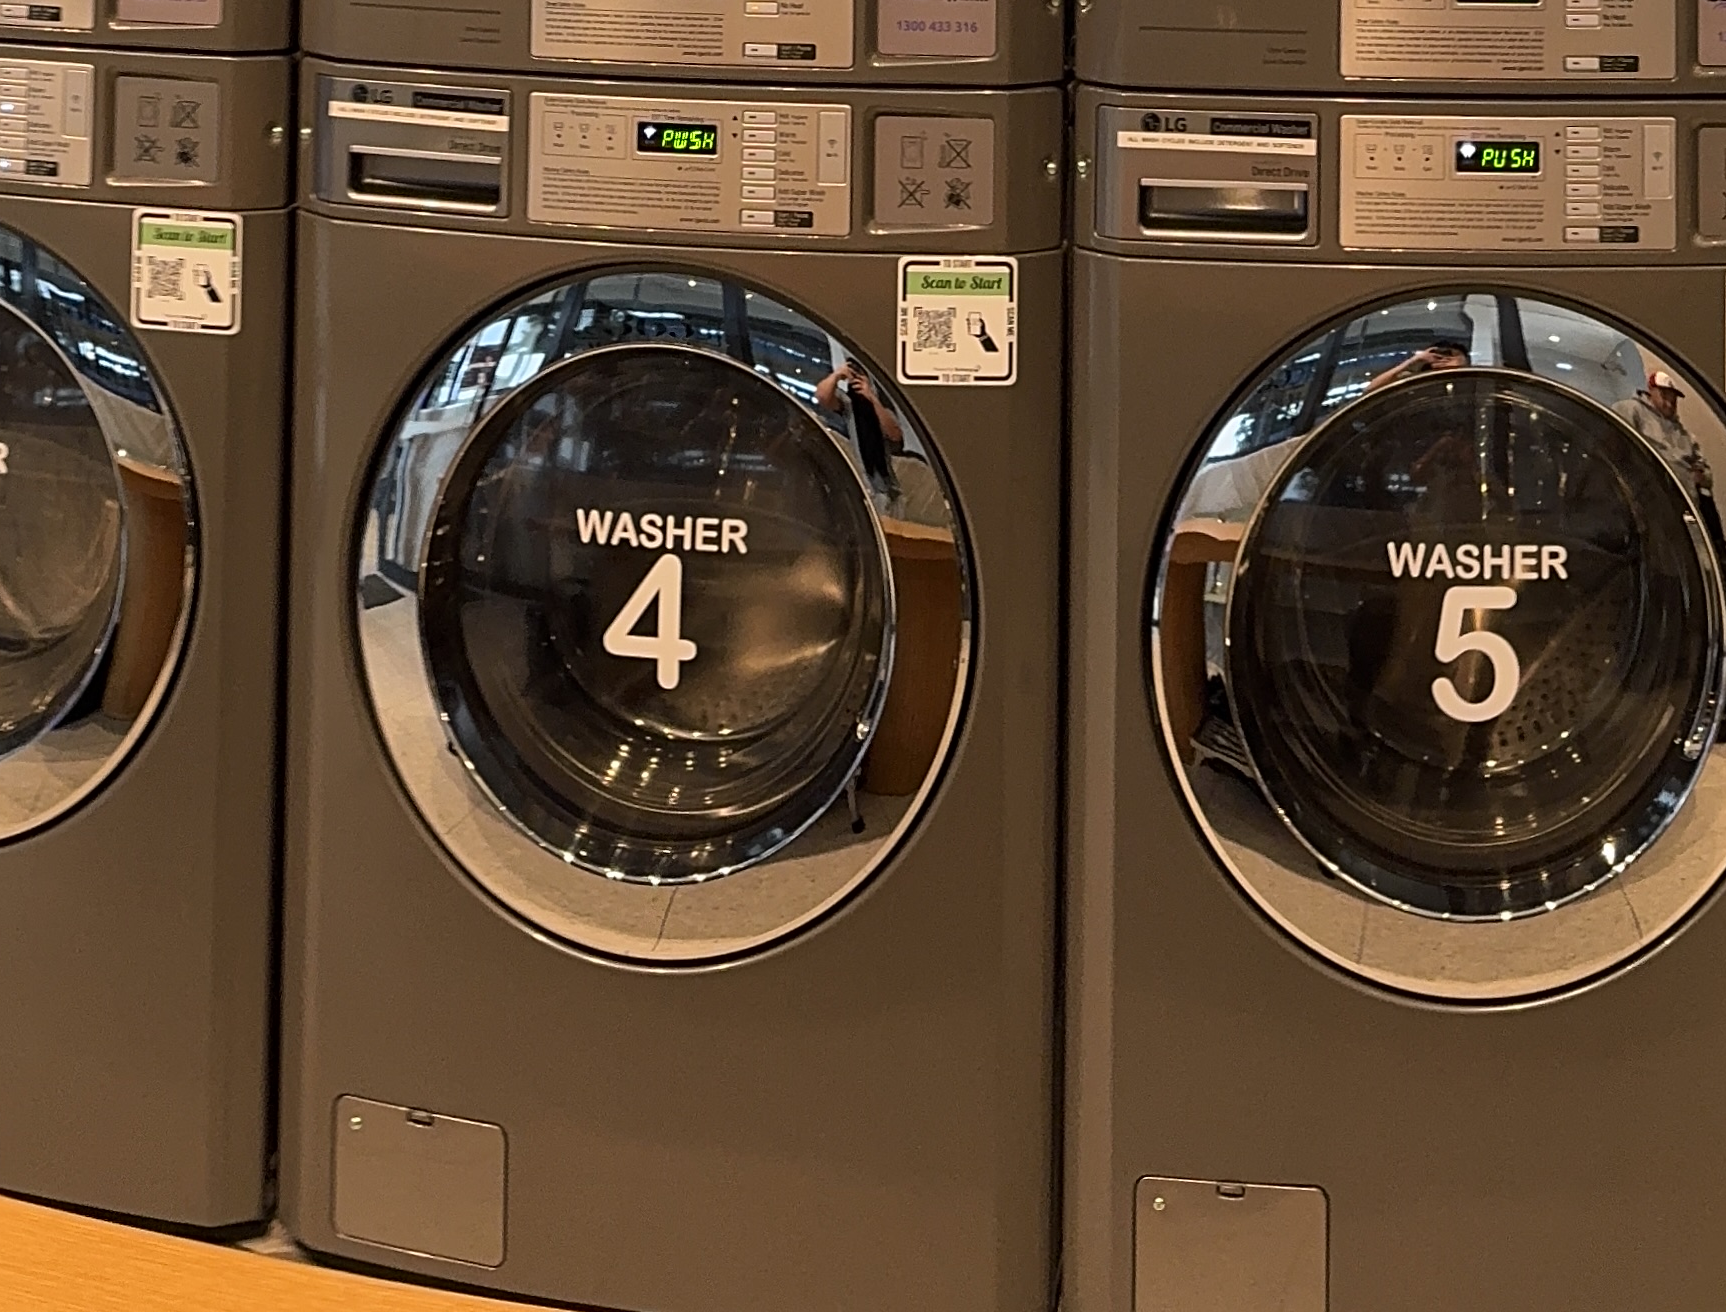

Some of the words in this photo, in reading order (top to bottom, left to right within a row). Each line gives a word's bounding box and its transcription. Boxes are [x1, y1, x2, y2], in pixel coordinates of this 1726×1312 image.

[896, 20, 926, 31] 1300
[929, 21, 951, 32] 433
[955, 21, 977, 33] 316
[1165, 117, 1187, 132] LG
[1481, 148, 1535, 169] PUSH
[921, 275, 951, 289] Scan
[954, 277, 966, 289] to
[970, 276, 1002, 289] Start
[576, 508, 748, 555] WASHER
[1386, 540, 1569, 582] WASHER
[602, 552, 696, 691] 4
[1430, 585, 1521, 722] 5
